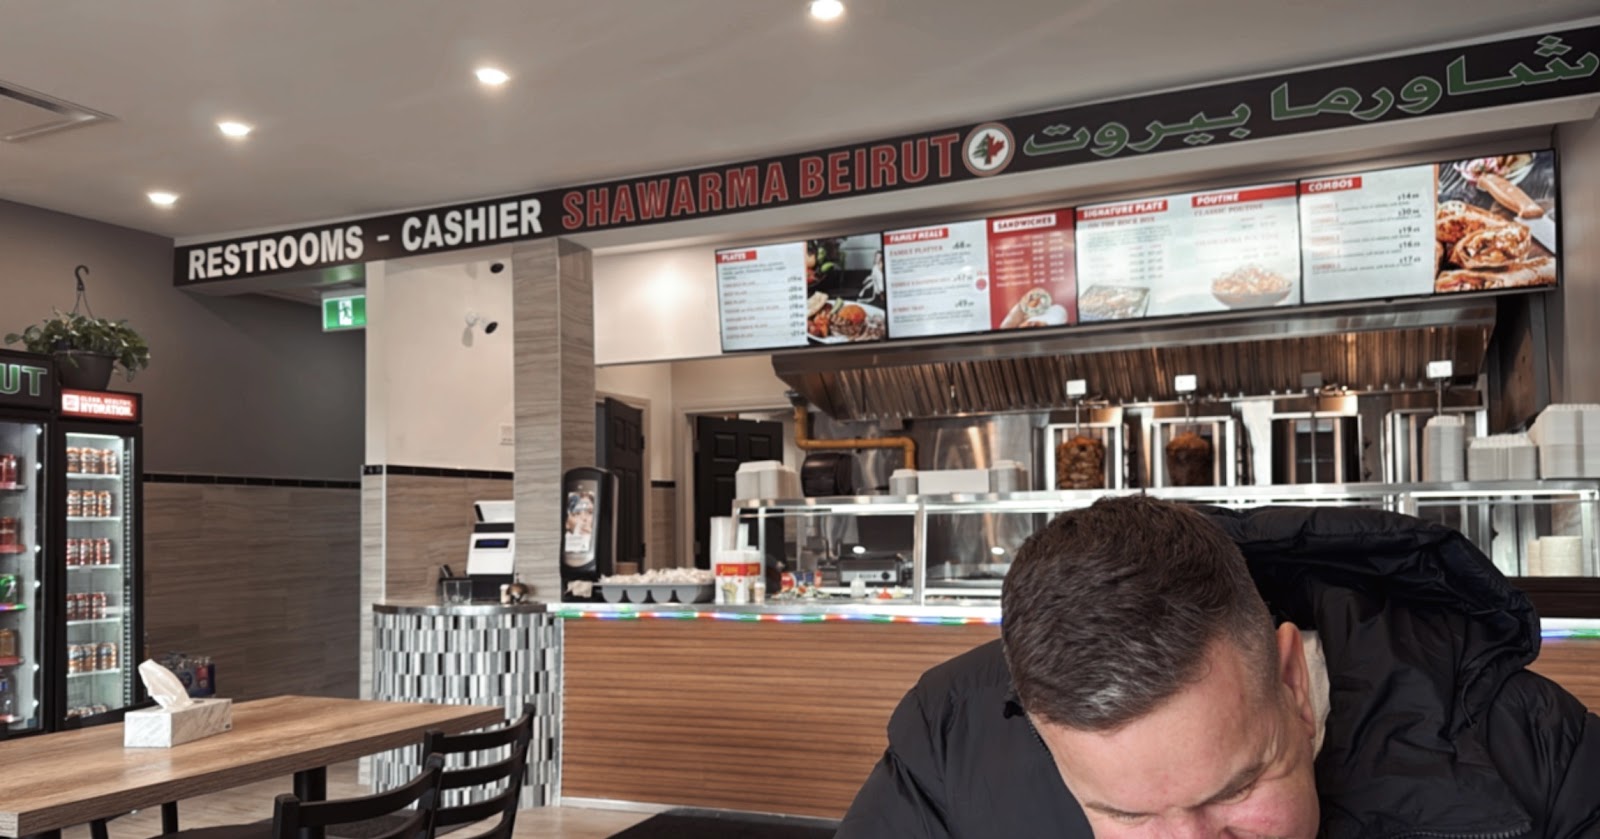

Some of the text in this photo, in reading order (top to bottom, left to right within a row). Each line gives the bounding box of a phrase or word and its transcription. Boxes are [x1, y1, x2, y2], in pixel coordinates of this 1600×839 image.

[1023, 35, 1599, 156] شاورما بيروت
[562, 133, 960, 229] SHAWARMA BEIRUT
[1308, 179, 1353, 192] COMBOS
[1197, 192, 1239, 206] POUTINE
[1084, 200, 1163, 219] SIGNATURE PLATE
[998, 216, 1052, 230] SANDWICHES
[188, 225, 364, 280] RESTROOMS
[402, 199, 542, 251] CASHIER
[890, 229, 943, 243] FAMILY MEALS
[722, 252, 747, 262] PLATES
